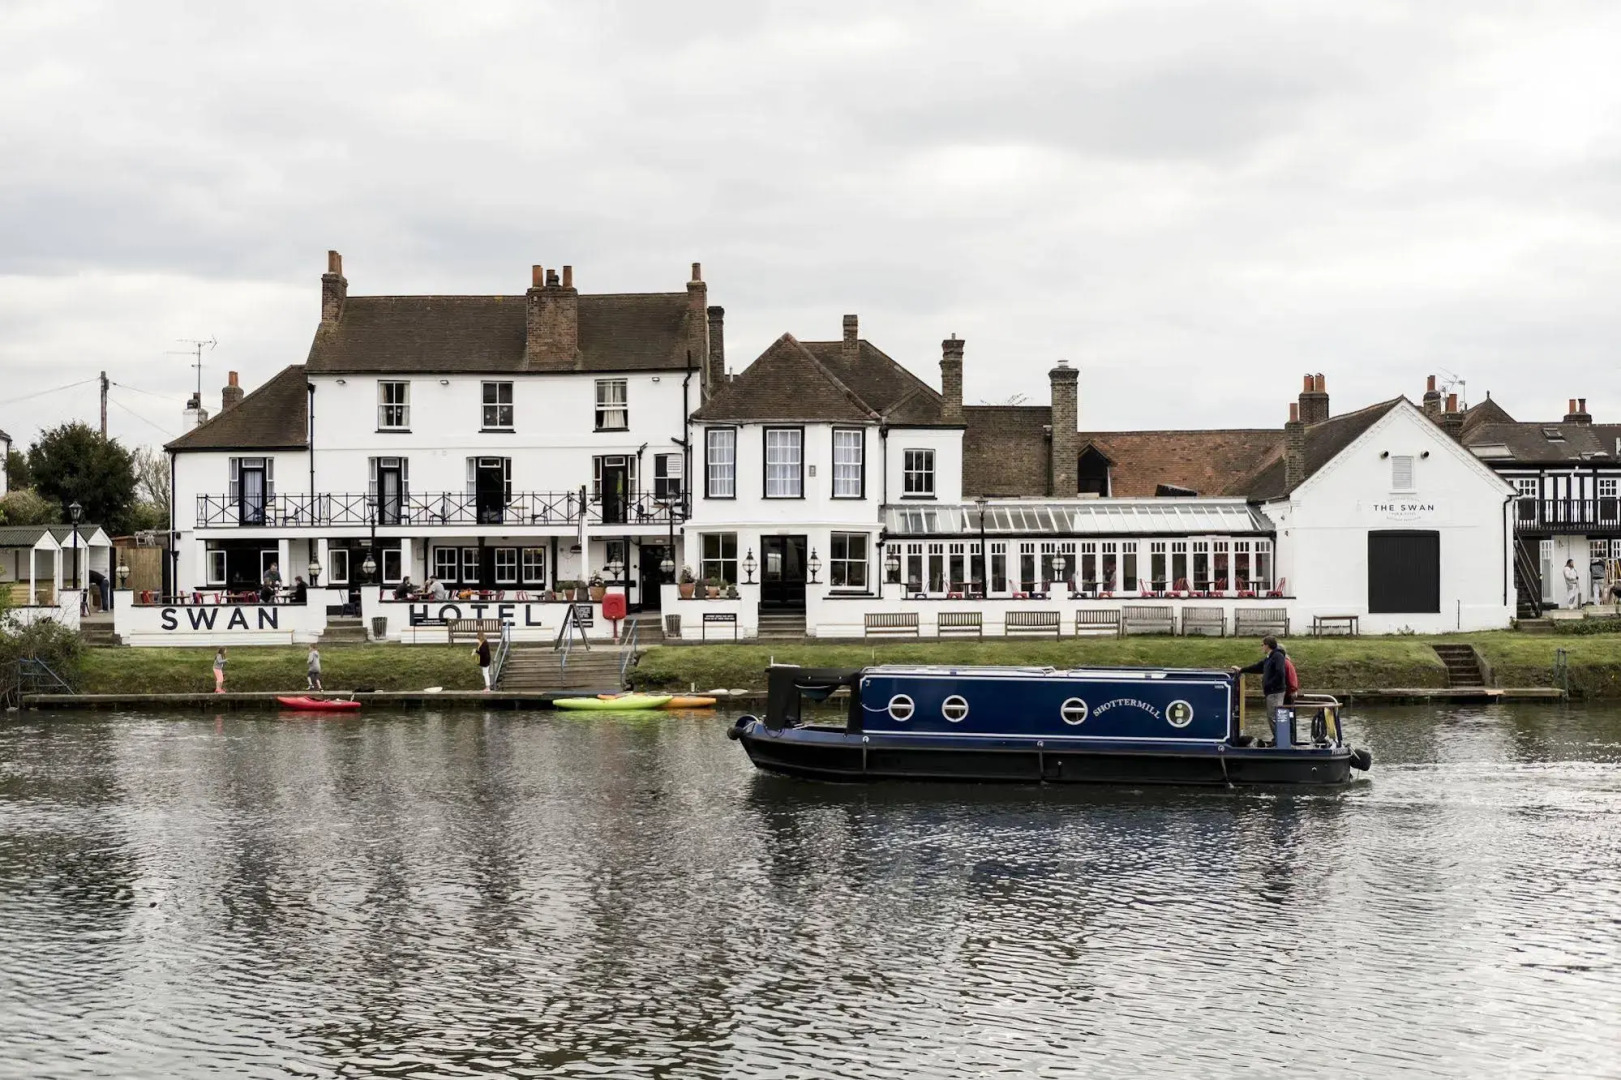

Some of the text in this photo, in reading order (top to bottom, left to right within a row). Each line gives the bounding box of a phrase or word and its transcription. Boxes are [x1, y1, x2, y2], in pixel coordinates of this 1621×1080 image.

[161, 604, 542, 631] SWAN HOTEL
[1092, 698, 1161, 719] SHOTTERMILL
